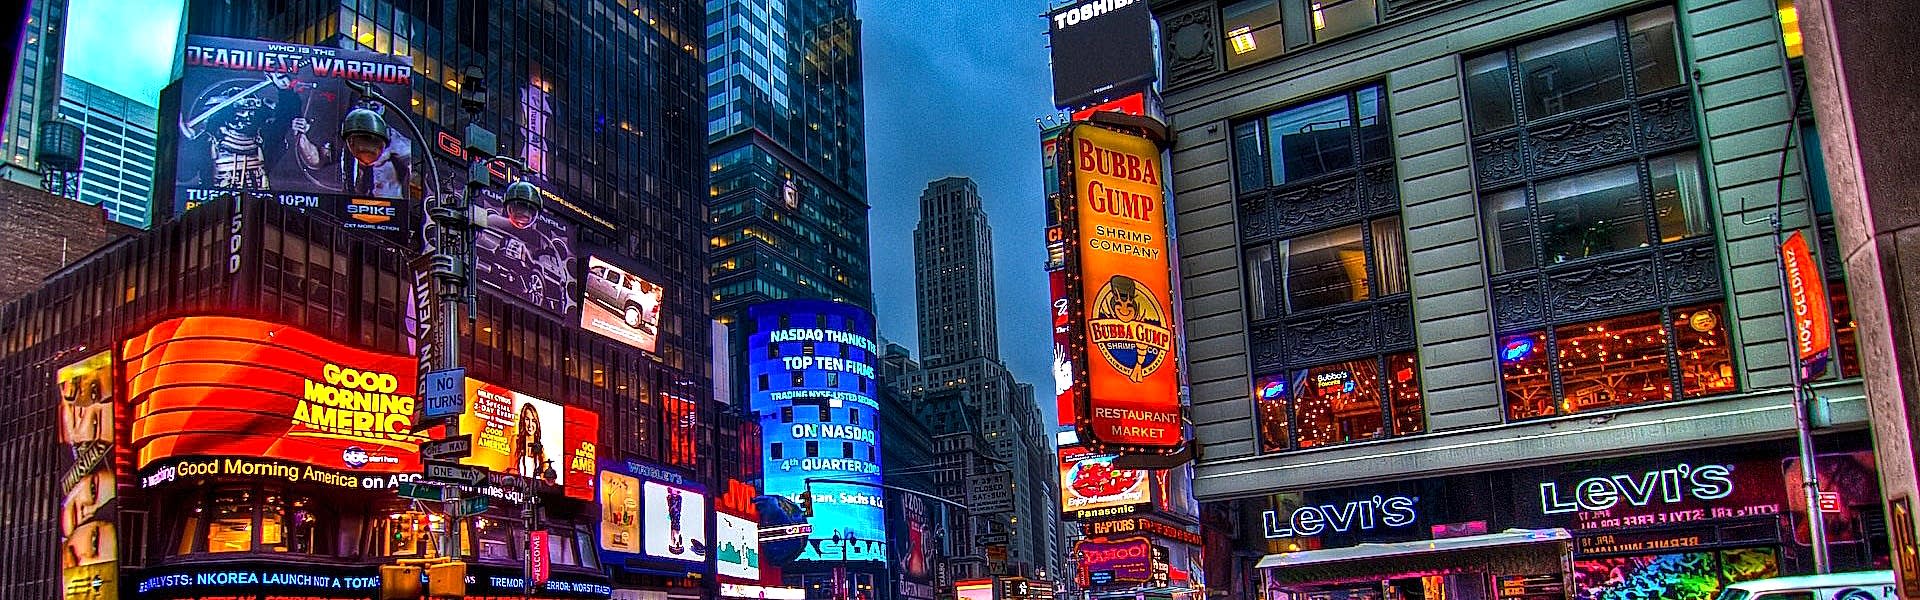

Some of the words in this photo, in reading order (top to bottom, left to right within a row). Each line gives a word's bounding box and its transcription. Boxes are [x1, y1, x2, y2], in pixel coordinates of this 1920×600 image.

[1054, 0, 1140, 30] TOSHIB
[268, 44, 295, 52] WHO
[312, 48, 336, 57] THE
[186, 45, 304, 74] DEADLIEST
[311, 56, 411, 85] WARRIOR
[1078, 137, 1158, 186] BUBBA
[279, 194, 319, 208] 10PM
[541, 190, 592, 219] PROFESSIONAL
[1087, 180, 1154, 222] GUMP
[346, 204, 396, 217] SPIKE
[229, 195, 243, 274] 1500
[1096, 225, 1152, 244] SHRIMP
[1089, 238, 1160, 260] COMPANY
[415, 269, 432, 340] VENIT
[770, 328, 823, 342] NASDAQ
[824, 329, 866, 350] THANKS
[1093, 322, 1134, 340] BUBBA
[1136, 323, 1169, 347] GUMP
[1107, 342, 1136, 350] SHRIMP
[782, 356, 813, 371] TOP
[815, 356, 843, 372] TEN
[845, 359, 875, 380] FIRMS
[323, 363, 398, 394] GOOD
[436, 377, 454, 392] NO
[304, 378, 415, 415] MORNING
[428, 394, 464, 409] TURNS
[770, 390, 808, 401] TRADING
[486, 400, 511, 413] SPECIAL
[1095, 407, 1177, 424] RESTAURANT
[480, 431, 508, 444] MORNING
[485, 427, 504, 437] GOOD
[791, 423, 818, 439] ON
[821, 424, 875, 446] NASDAQ
[1111, 425, 1165, 438] MARKET
[449, 441, 465, 452] WAY
[477, 438, 511, 453] AMERICA
[343, 449, 369, 465] abc
[433, 466, 453, 476] ONE
[461, 469, 480, 481] WAY
[627, 461, 683, 485] WRIGLEY'S
[781, 458, 799, 472] 4th
[801, 458, 863, 473] QUARTER
[177, 459, 219, 476] Good
[224, 459, 299, 481] Morning
[302, 465, 358, 488] America
[362, 477, 384, 489] on
[410, 486, 417, 497] 7
[974, 483, 1004, 493] CLOSED
[723, 478, 757, 515] JVC
[839, 492, 870, 506] Sachs
[870, 496, 877, 507] &
[1077, 504, 1134, 519] Panasonic
[1094, 519, 1135, 535] RAPTORS
[532, 535, 541, 583] WELCOME
[1083, 543, 1147, 564] YAHOO!
[197, 573, 258, 586] NKOREA
[262, 573, 311, 586] LAUNCH
[313, 576, 330, 587] NOT
[332, 577, 341, 588] A
[490, 576, 524, 589] TREMOR
